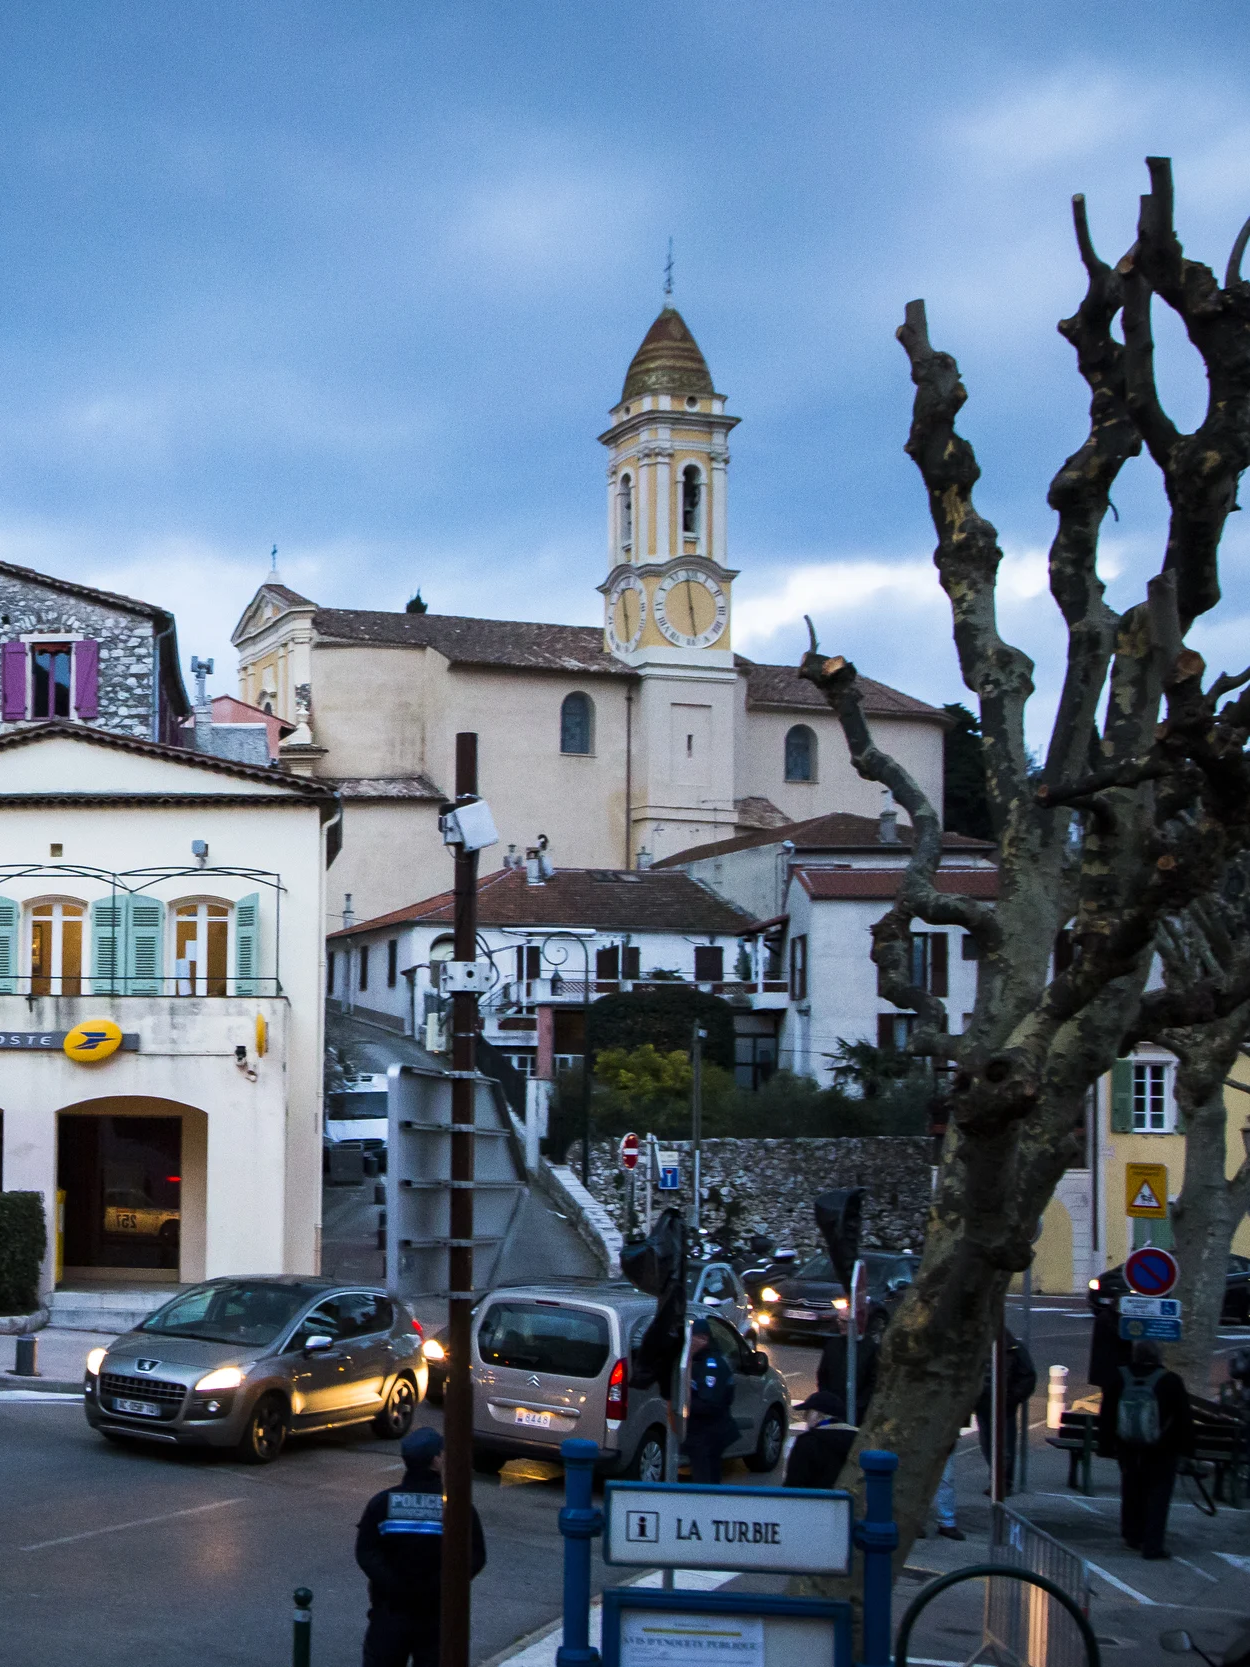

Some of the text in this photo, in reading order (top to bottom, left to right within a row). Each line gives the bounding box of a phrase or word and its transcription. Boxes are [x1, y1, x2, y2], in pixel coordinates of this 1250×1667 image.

[391, 1494, 443, 1509] POLICE
[676, 1518, 702, 1541] LA
[712, 1519, 781, 1544] TURBIE
